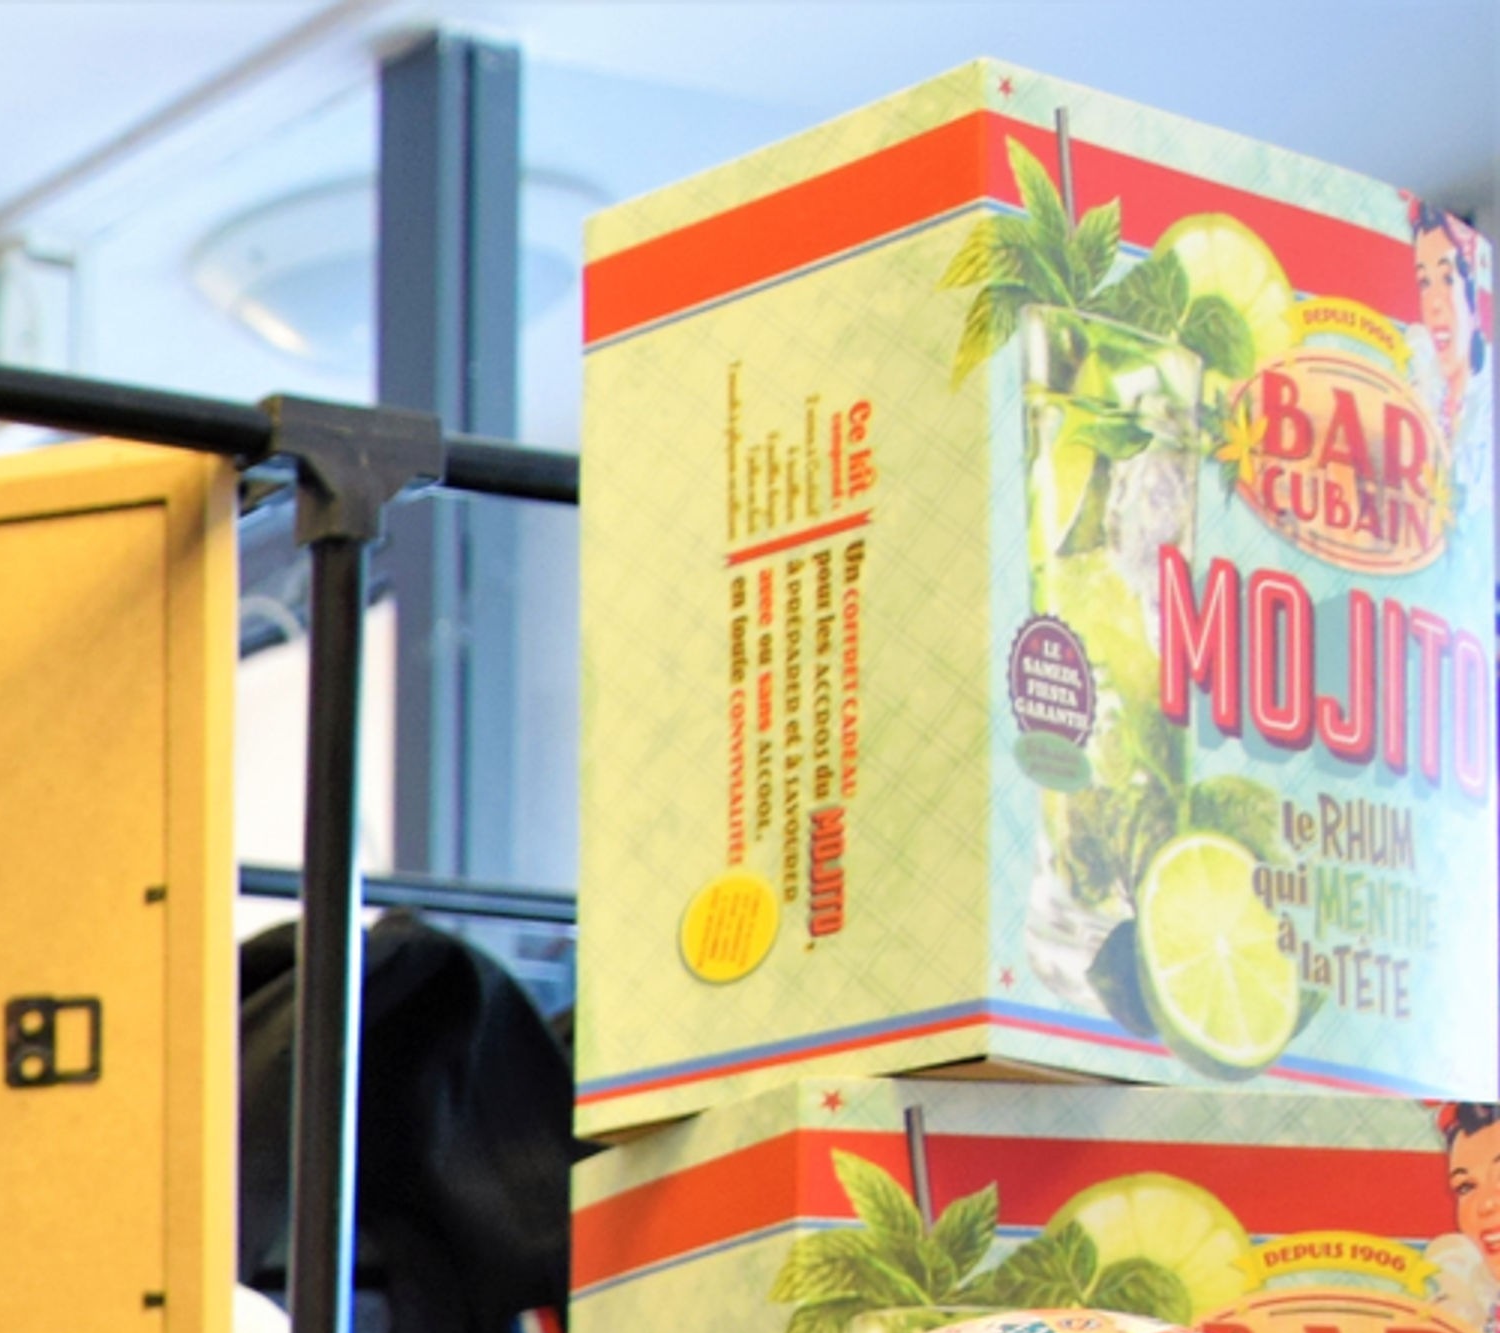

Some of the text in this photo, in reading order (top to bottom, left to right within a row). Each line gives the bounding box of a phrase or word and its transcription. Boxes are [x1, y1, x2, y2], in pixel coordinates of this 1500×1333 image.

[849, 400, 872, 443] Ce
[1261, 368, 1429, 498] BAR
[1262, 464, 1431, 552] CUBAIN
[812, 548, 833, 610] pour
[844, 538, 865, 584] Un
[758, 633, 774, 667] ou
[816, 612, 836, 656] les
[1042, 638, 1063, 661] LE
[1025, 677, 1079, 709] FIESTA
[1158, 543, 1489, 798] MOJITO
[813, 663, 832, 759] ACCROS
[840, 697, 858, 799] CADEAU
[813, 760, 835, 800] du
[1317, 792, 1417, 874] RHUM
[1252, 861, 1440, 952] qui MENTHE
[1300, 940, 1332, 987] la
[1332, 936, 1411, 1021] TÊTE
[1262, 1241, 1407, 1273] DEPUIS 1906
